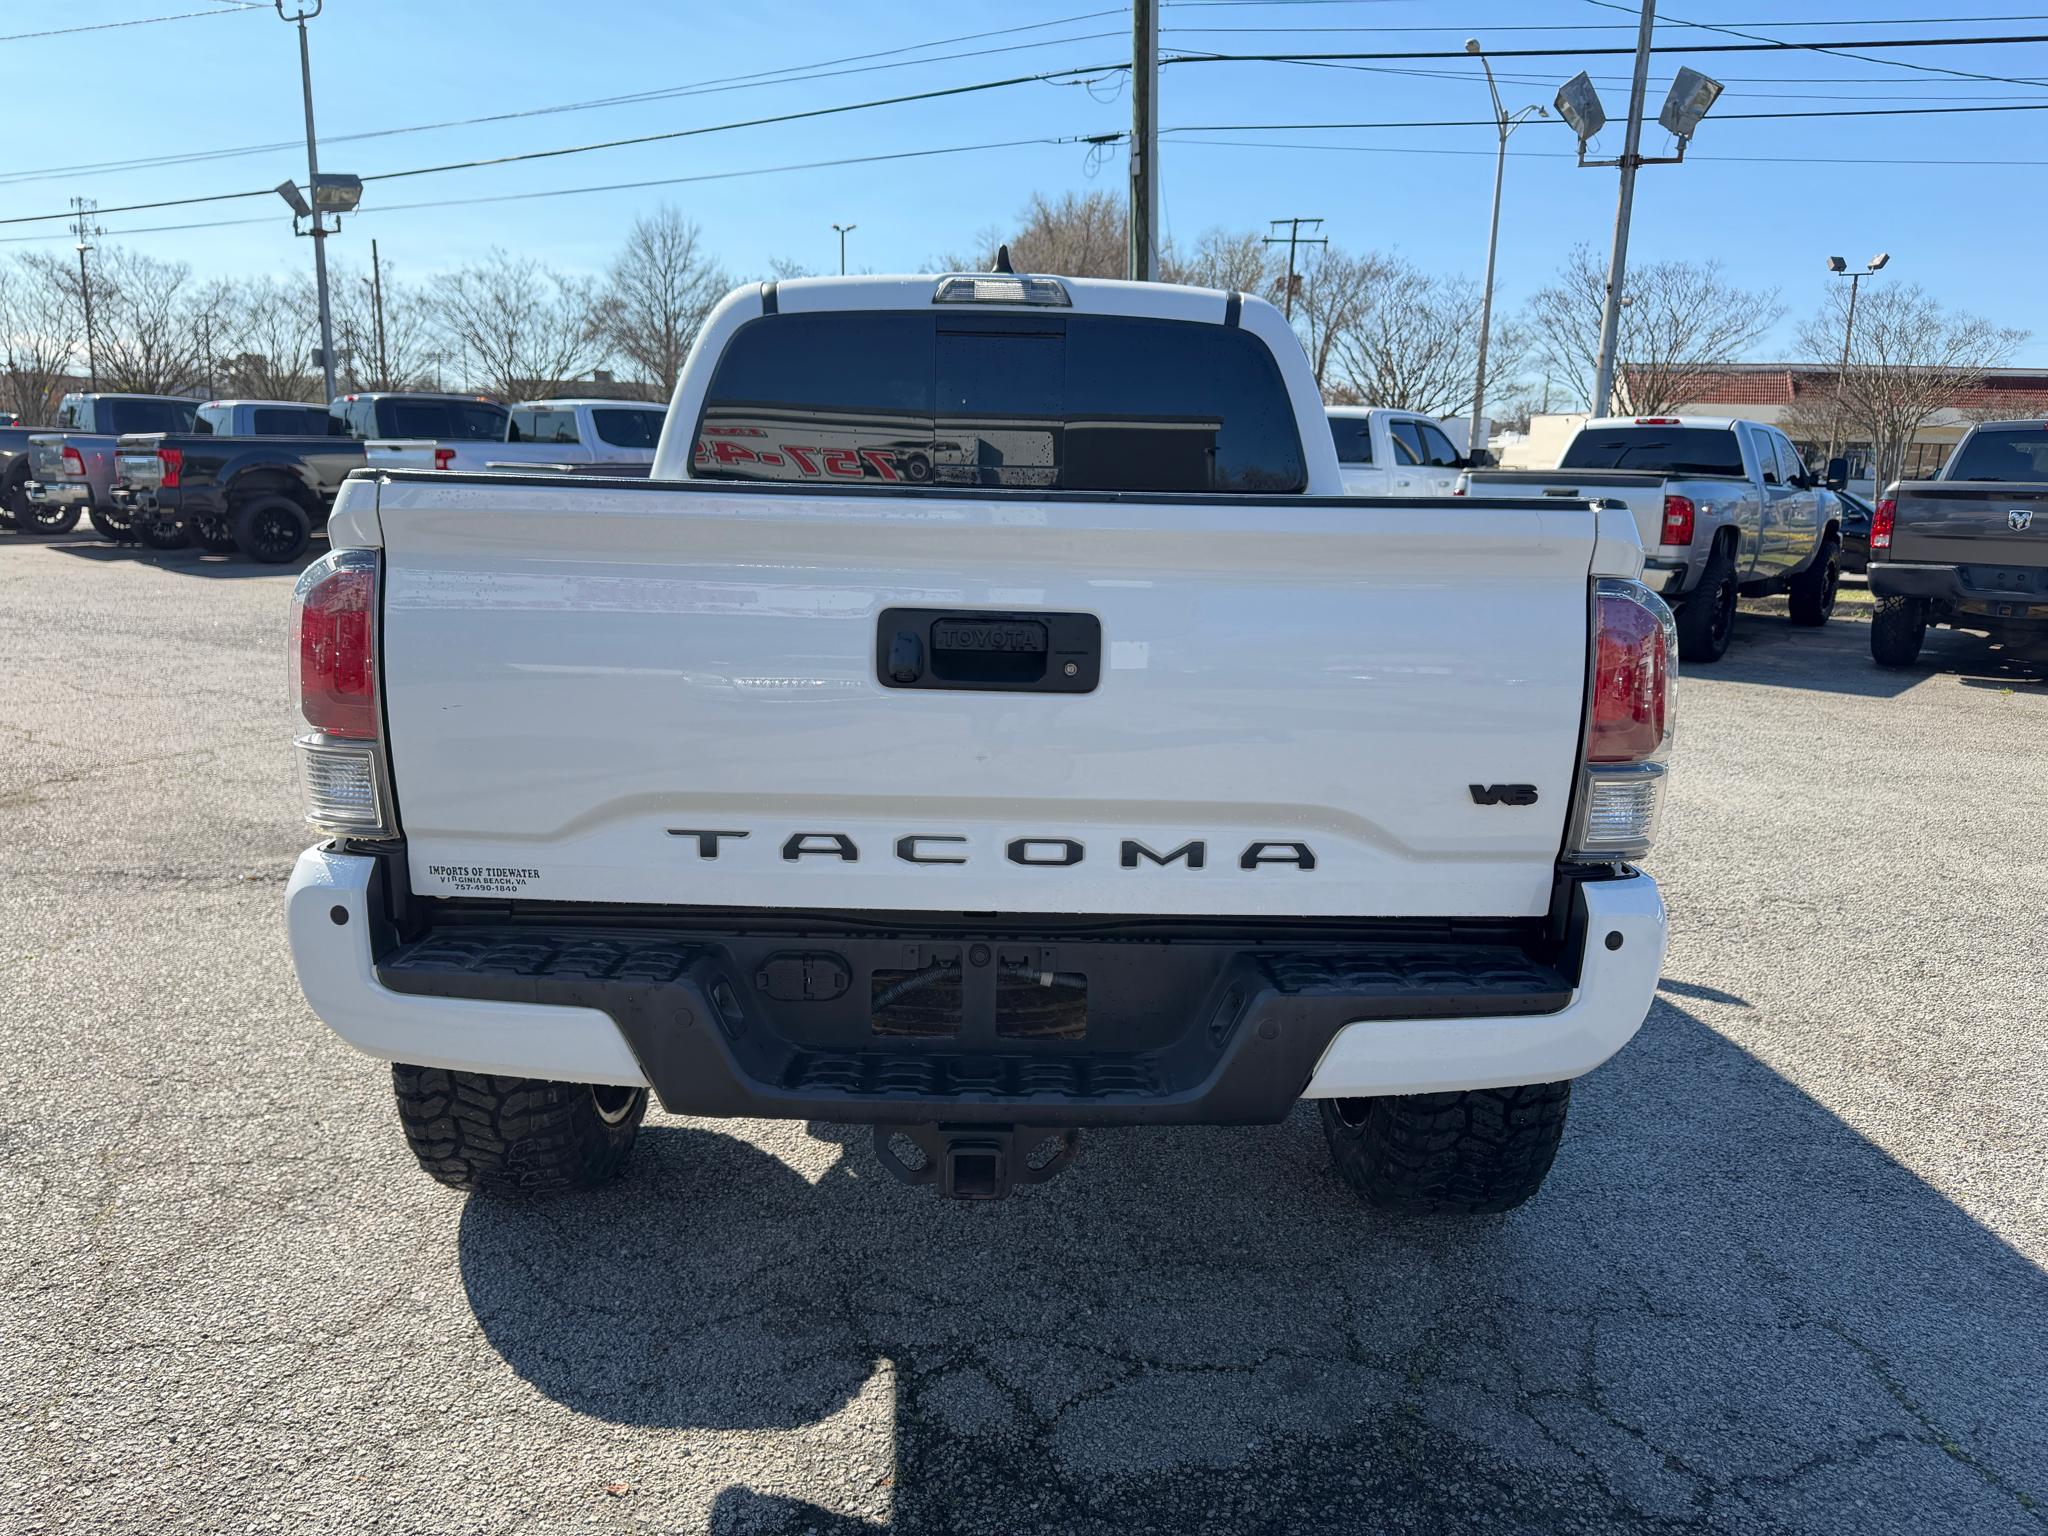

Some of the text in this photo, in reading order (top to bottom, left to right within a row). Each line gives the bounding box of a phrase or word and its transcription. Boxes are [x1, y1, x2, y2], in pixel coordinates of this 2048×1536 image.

[942, 629, 1037, 650] TOYOTA
[1469, 784, 1539, 806] V6
[667, 829, 1317, 869] TACOMA
[428, 865, 540, 879] IMPORTS OF TIDEWATER
[455, 884, 517, 892] 757-490-1840
